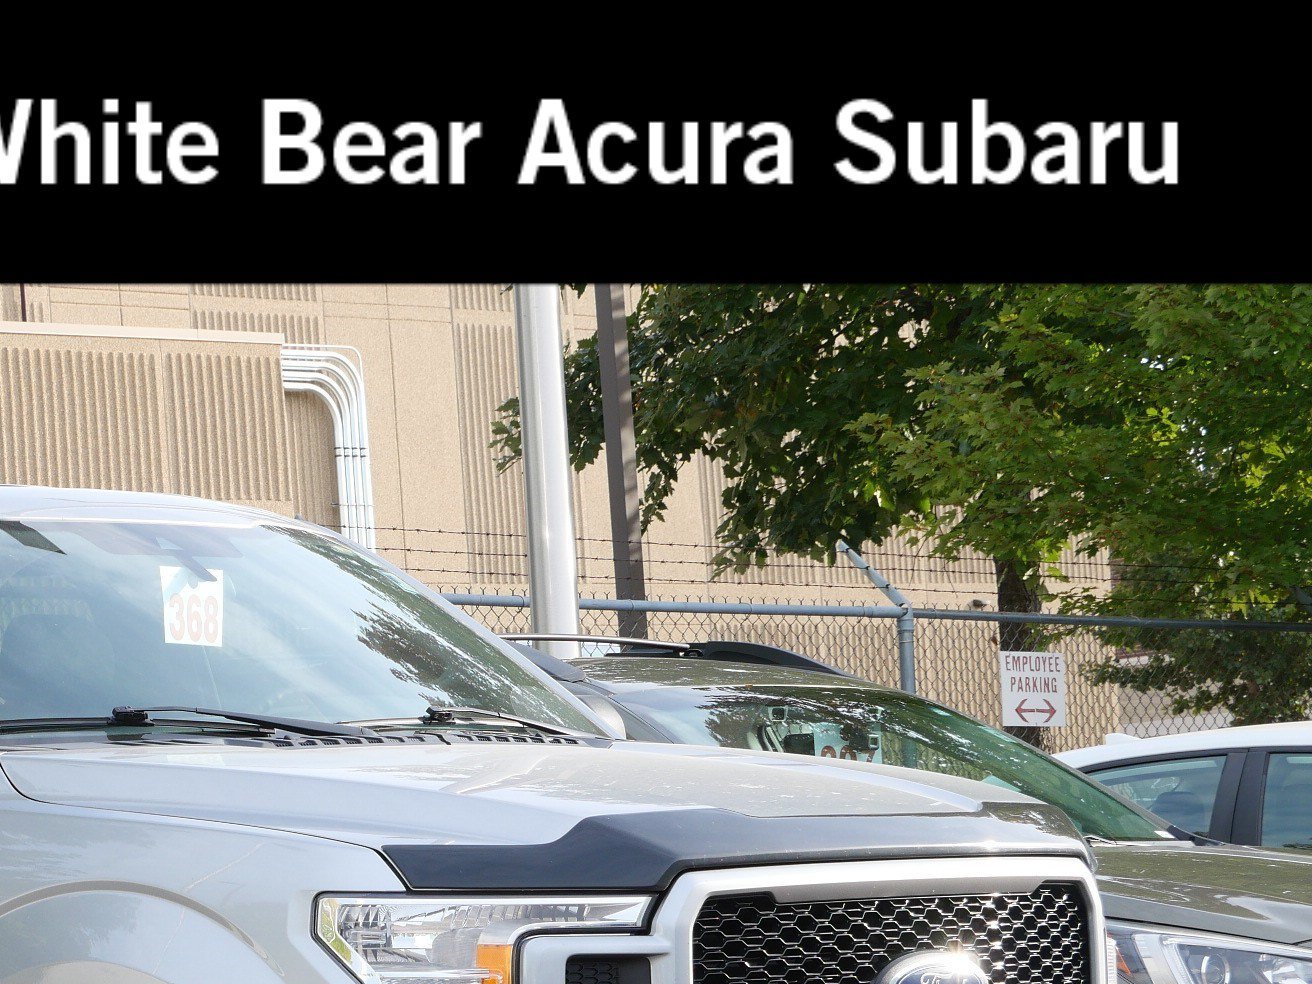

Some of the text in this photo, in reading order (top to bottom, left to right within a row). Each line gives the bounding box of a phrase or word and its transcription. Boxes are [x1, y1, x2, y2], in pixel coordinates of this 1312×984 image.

[168, 592, 219, 643] 368
[1004, 655, 1061, 672] EMPLOYEE
[1010, 676, 1058, 693] PARKING
